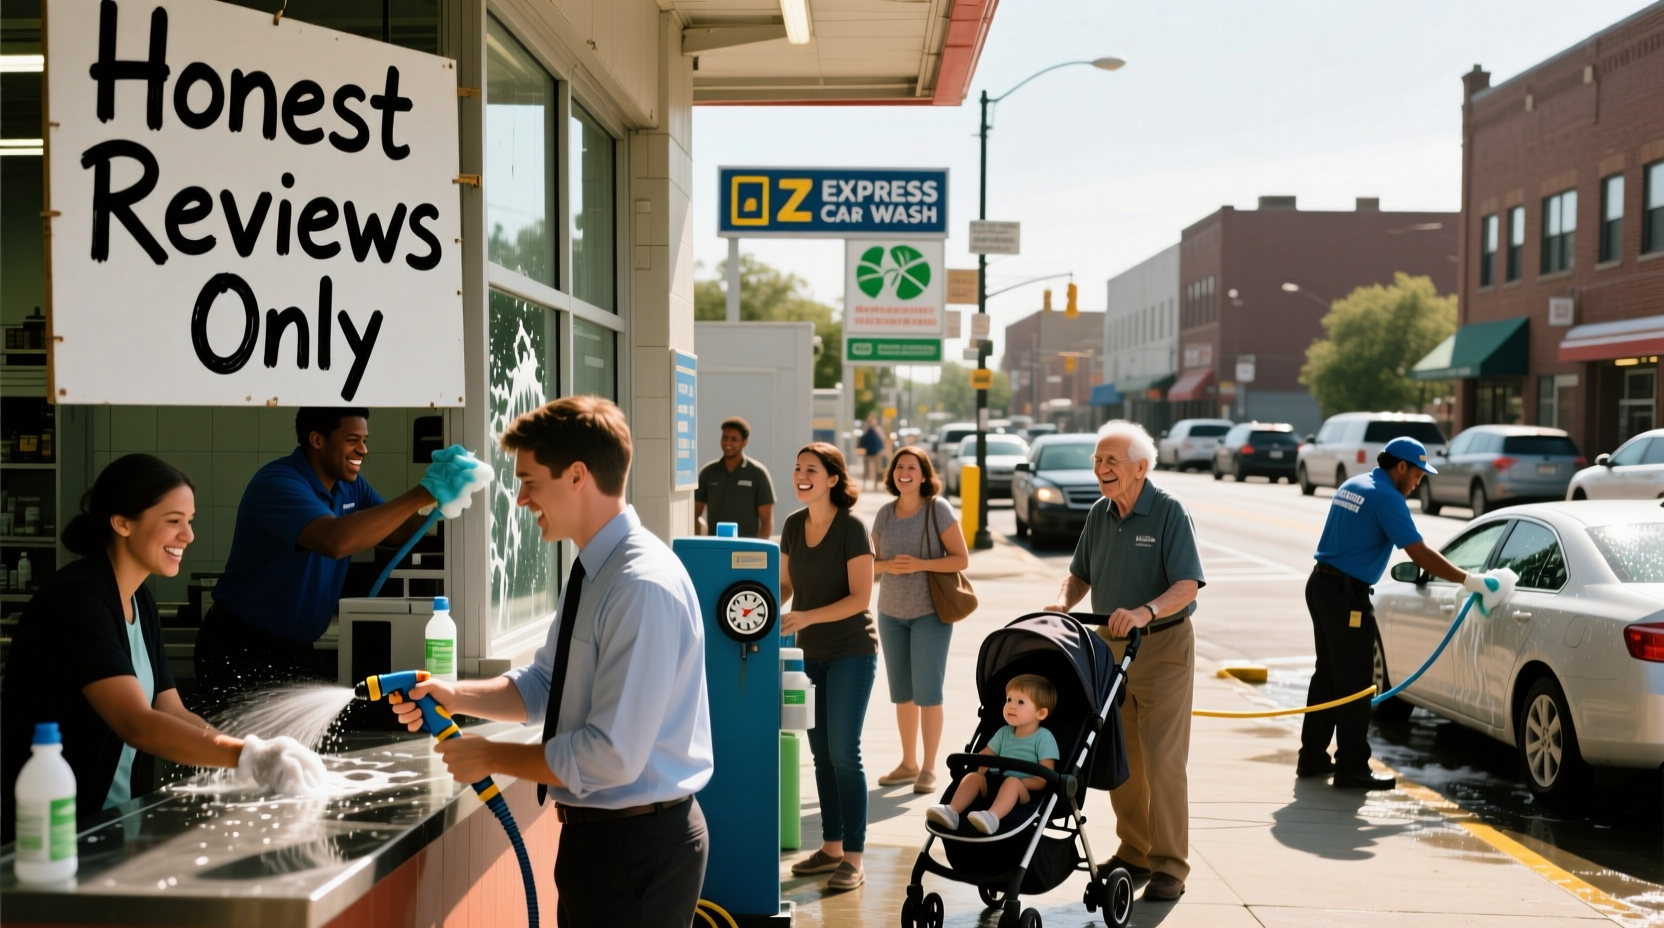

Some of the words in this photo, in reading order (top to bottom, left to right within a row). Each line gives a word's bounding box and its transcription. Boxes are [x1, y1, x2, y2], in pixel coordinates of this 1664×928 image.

[90, 0, 413, 161] Honest
[81, 139, 442, 271] Reviews
[820, 204, 863, 223] CAR
[870, 205, 938, 224] WASH
[821, 179, 938, 203] EXPRESS
[190, 272, 384, 402] Only
